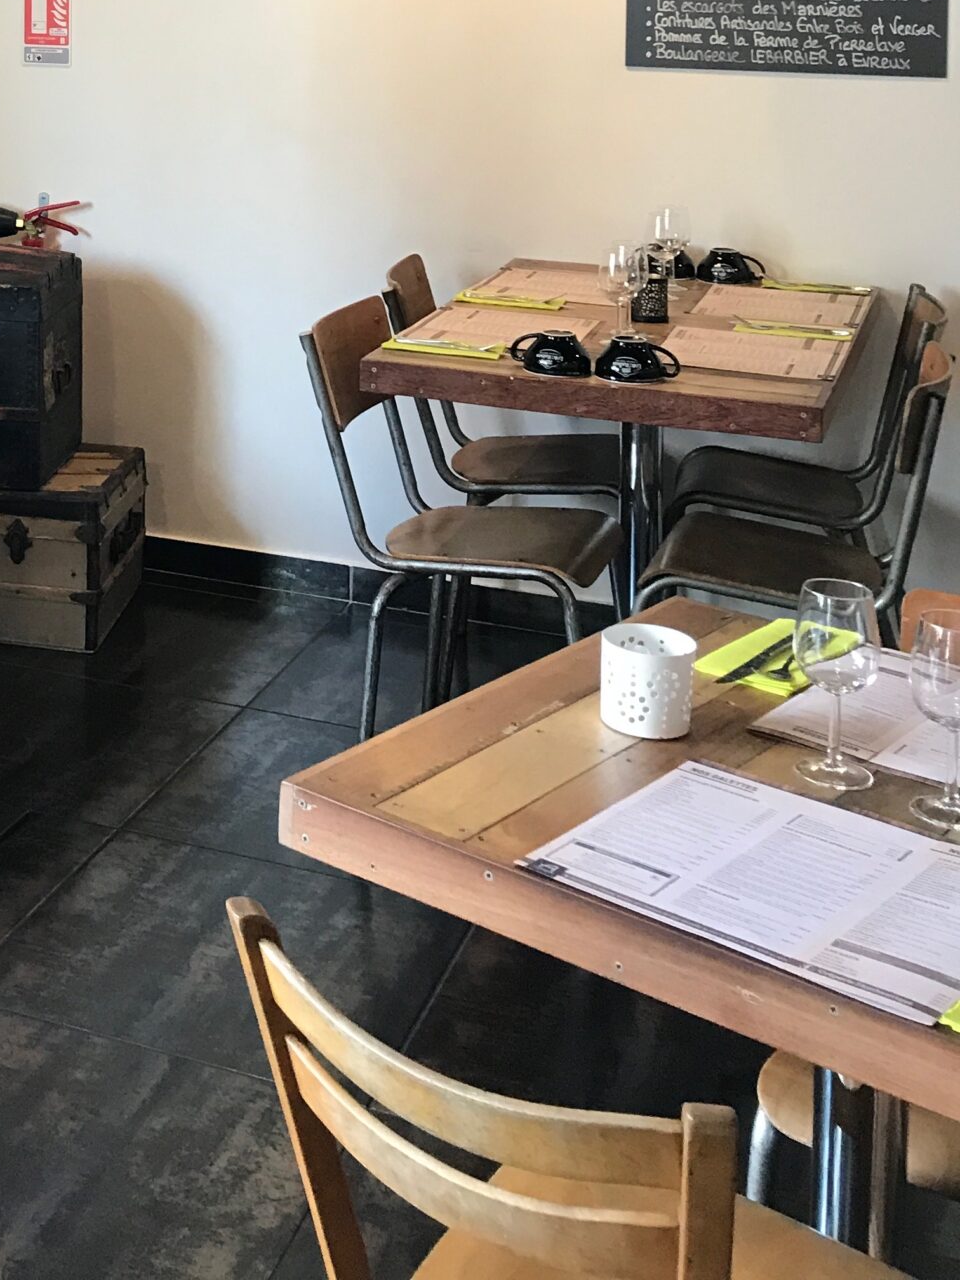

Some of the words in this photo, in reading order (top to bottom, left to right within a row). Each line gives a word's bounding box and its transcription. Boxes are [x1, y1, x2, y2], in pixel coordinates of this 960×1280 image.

[656, 0, 676, 13] Les
[752, 0, 778, 15] des
[720, 16, 793, 32] Artisanales
[835, 18, 864, 34] Bois
[871, 16, 886, 33] et
[709, 30, 728, 45] de
[734, 30, 749, 47] la
[803, 35, 821, 51] de
